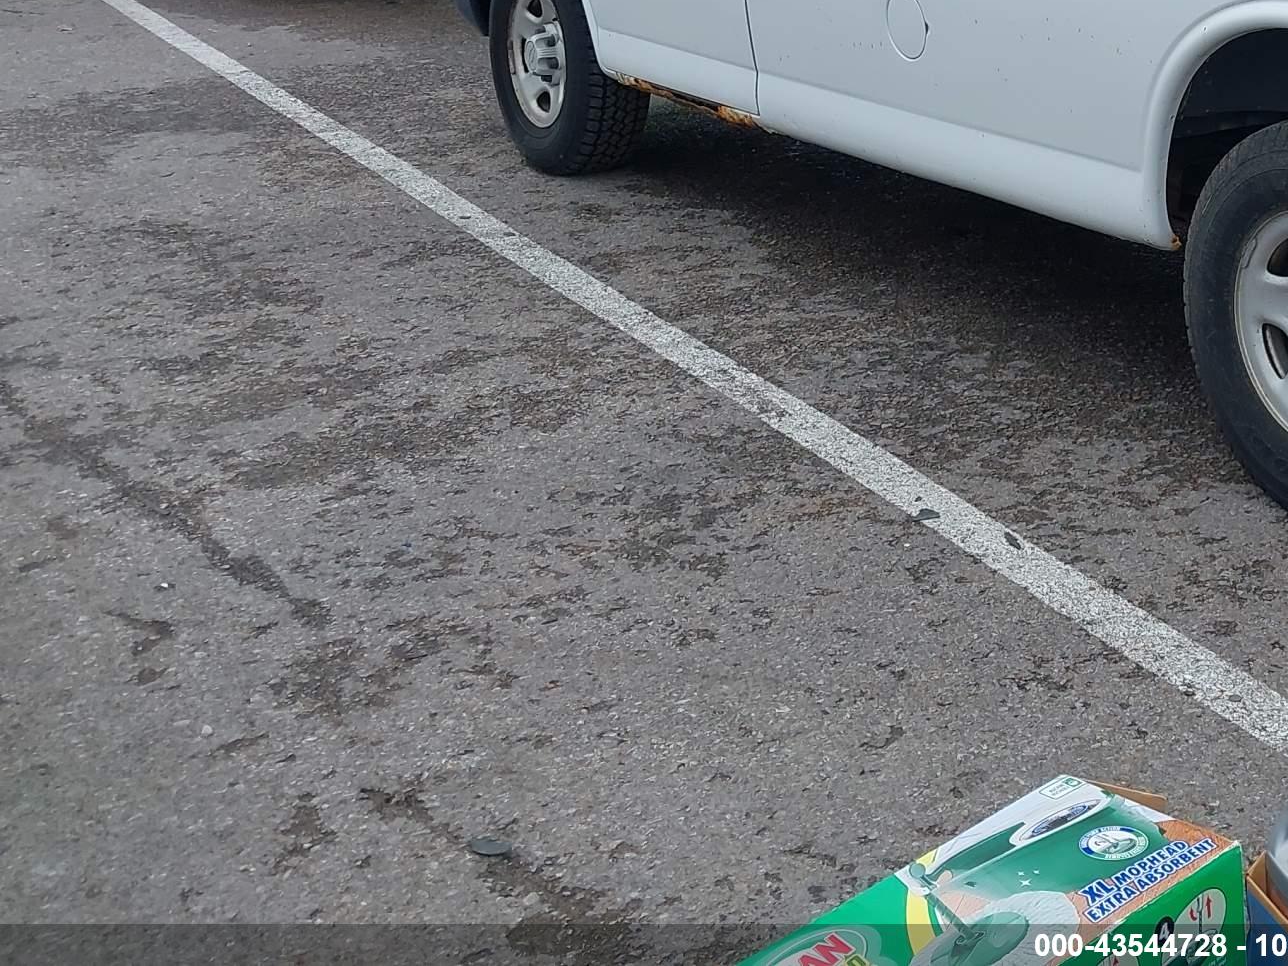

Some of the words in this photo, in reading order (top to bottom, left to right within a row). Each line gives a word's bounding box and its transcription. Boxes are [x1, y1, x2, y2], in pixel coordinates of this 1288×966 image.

[1081, 879, 1114, 904] XL
[1113, 841, 1188, 886] MOPHEAD
[1086, 887, 1139, 921] EXTRA
[1138, 839, 1216, 891] ABSORBENT
